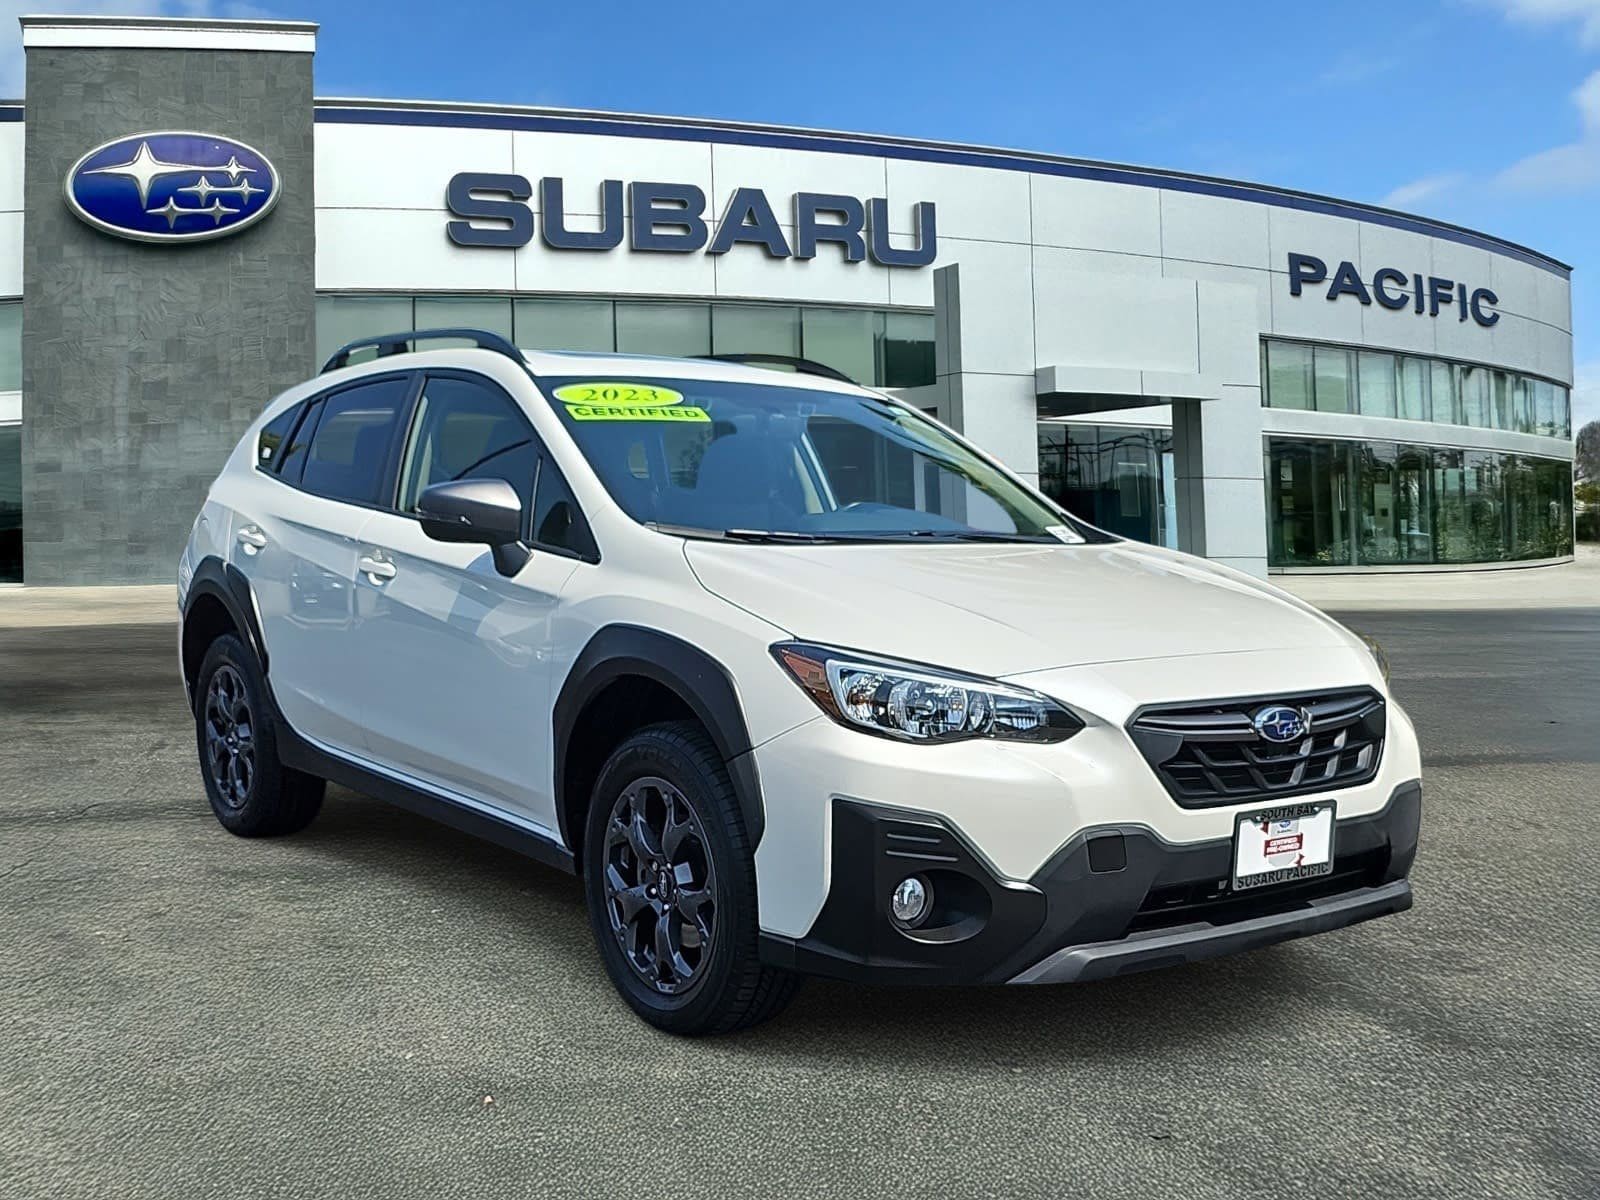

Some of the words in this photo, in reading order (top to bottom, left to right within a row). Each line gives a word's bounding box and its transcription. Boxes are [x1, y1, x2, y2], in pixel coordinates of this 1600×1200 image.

[445, 171, 937, 267] SUBARU
[1287, 251, 1500, 327] PACIFIC
[582, 388, 659, 402] 2023
[574, 406, 700, 418] CERTIFIED
[1262, 808, 1295, 820] SOUTH
[1298, 805, 1314, 815] BAY
[1238, 870, 1283, 888] SUBARU
[1286, 863, 1328, 879] PACIFIC
